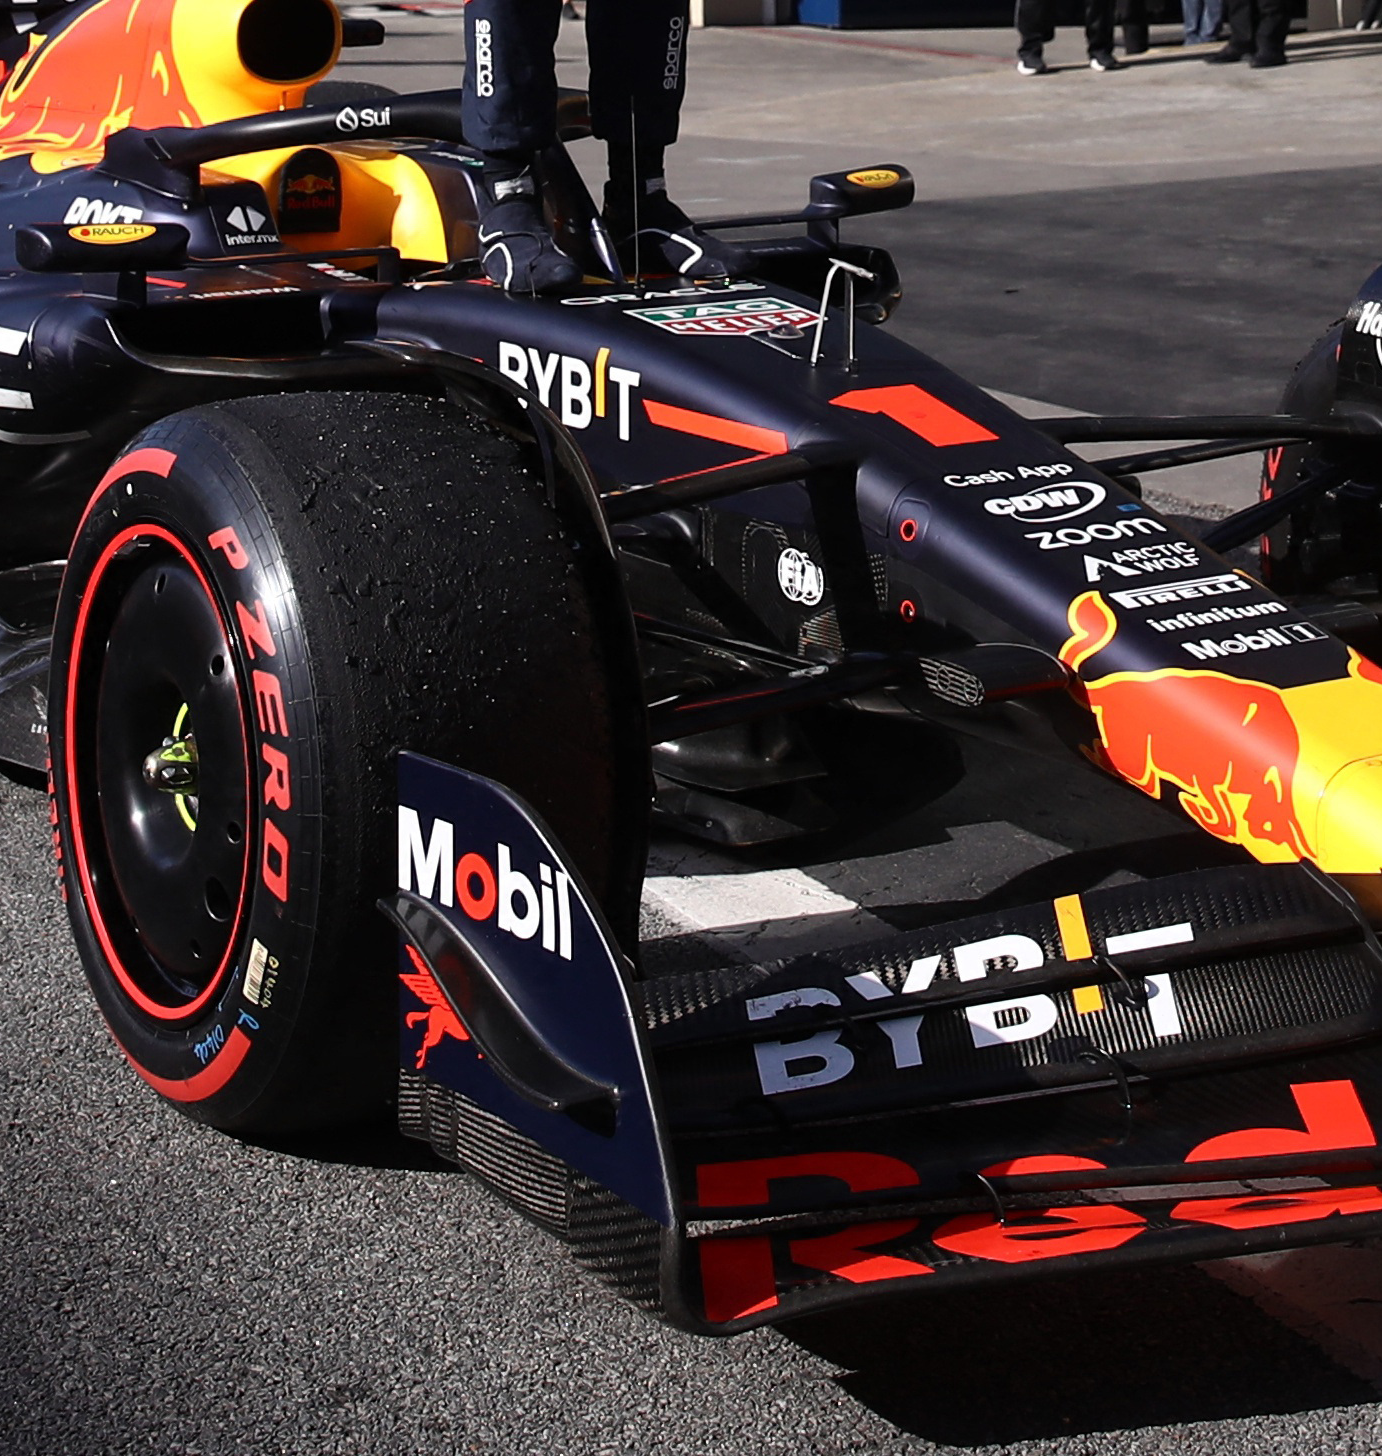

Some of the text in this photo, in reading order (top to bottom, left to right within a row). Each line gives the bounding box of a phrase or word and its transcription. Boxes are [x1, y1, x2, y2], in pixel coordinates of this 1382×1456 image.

[360, 106, 391, 128] Sui
[312, 195, 336, 208] Bull
[91, 226, 145, 236] RAUCH
[224, 232, 280, 246] inter.mx
[560, 282, 767, 306] ORACLE
[644, 301, 781, 319] TAG
[671, 312, 810, 332] HEUER
[943, 461, 1074, 488] Cash App
[984, 487, 1081, 516] CDW
[1024, 516, 1168, 550] zoom
[1112, 541, 1197, 564] ARCTIC
[1133, 554, 1201, 574] WOLF
[1108, 573, 1252, 610] PIRELLI
[1146, 598, 1288, 633] infinitum
[1180, 627, 1293, 661] Mobil
[207, 525, 290, 905] P ZERO
[398, 804, 574, 961] Mobil
[745, 893, 1194, 1095] BYBIT
